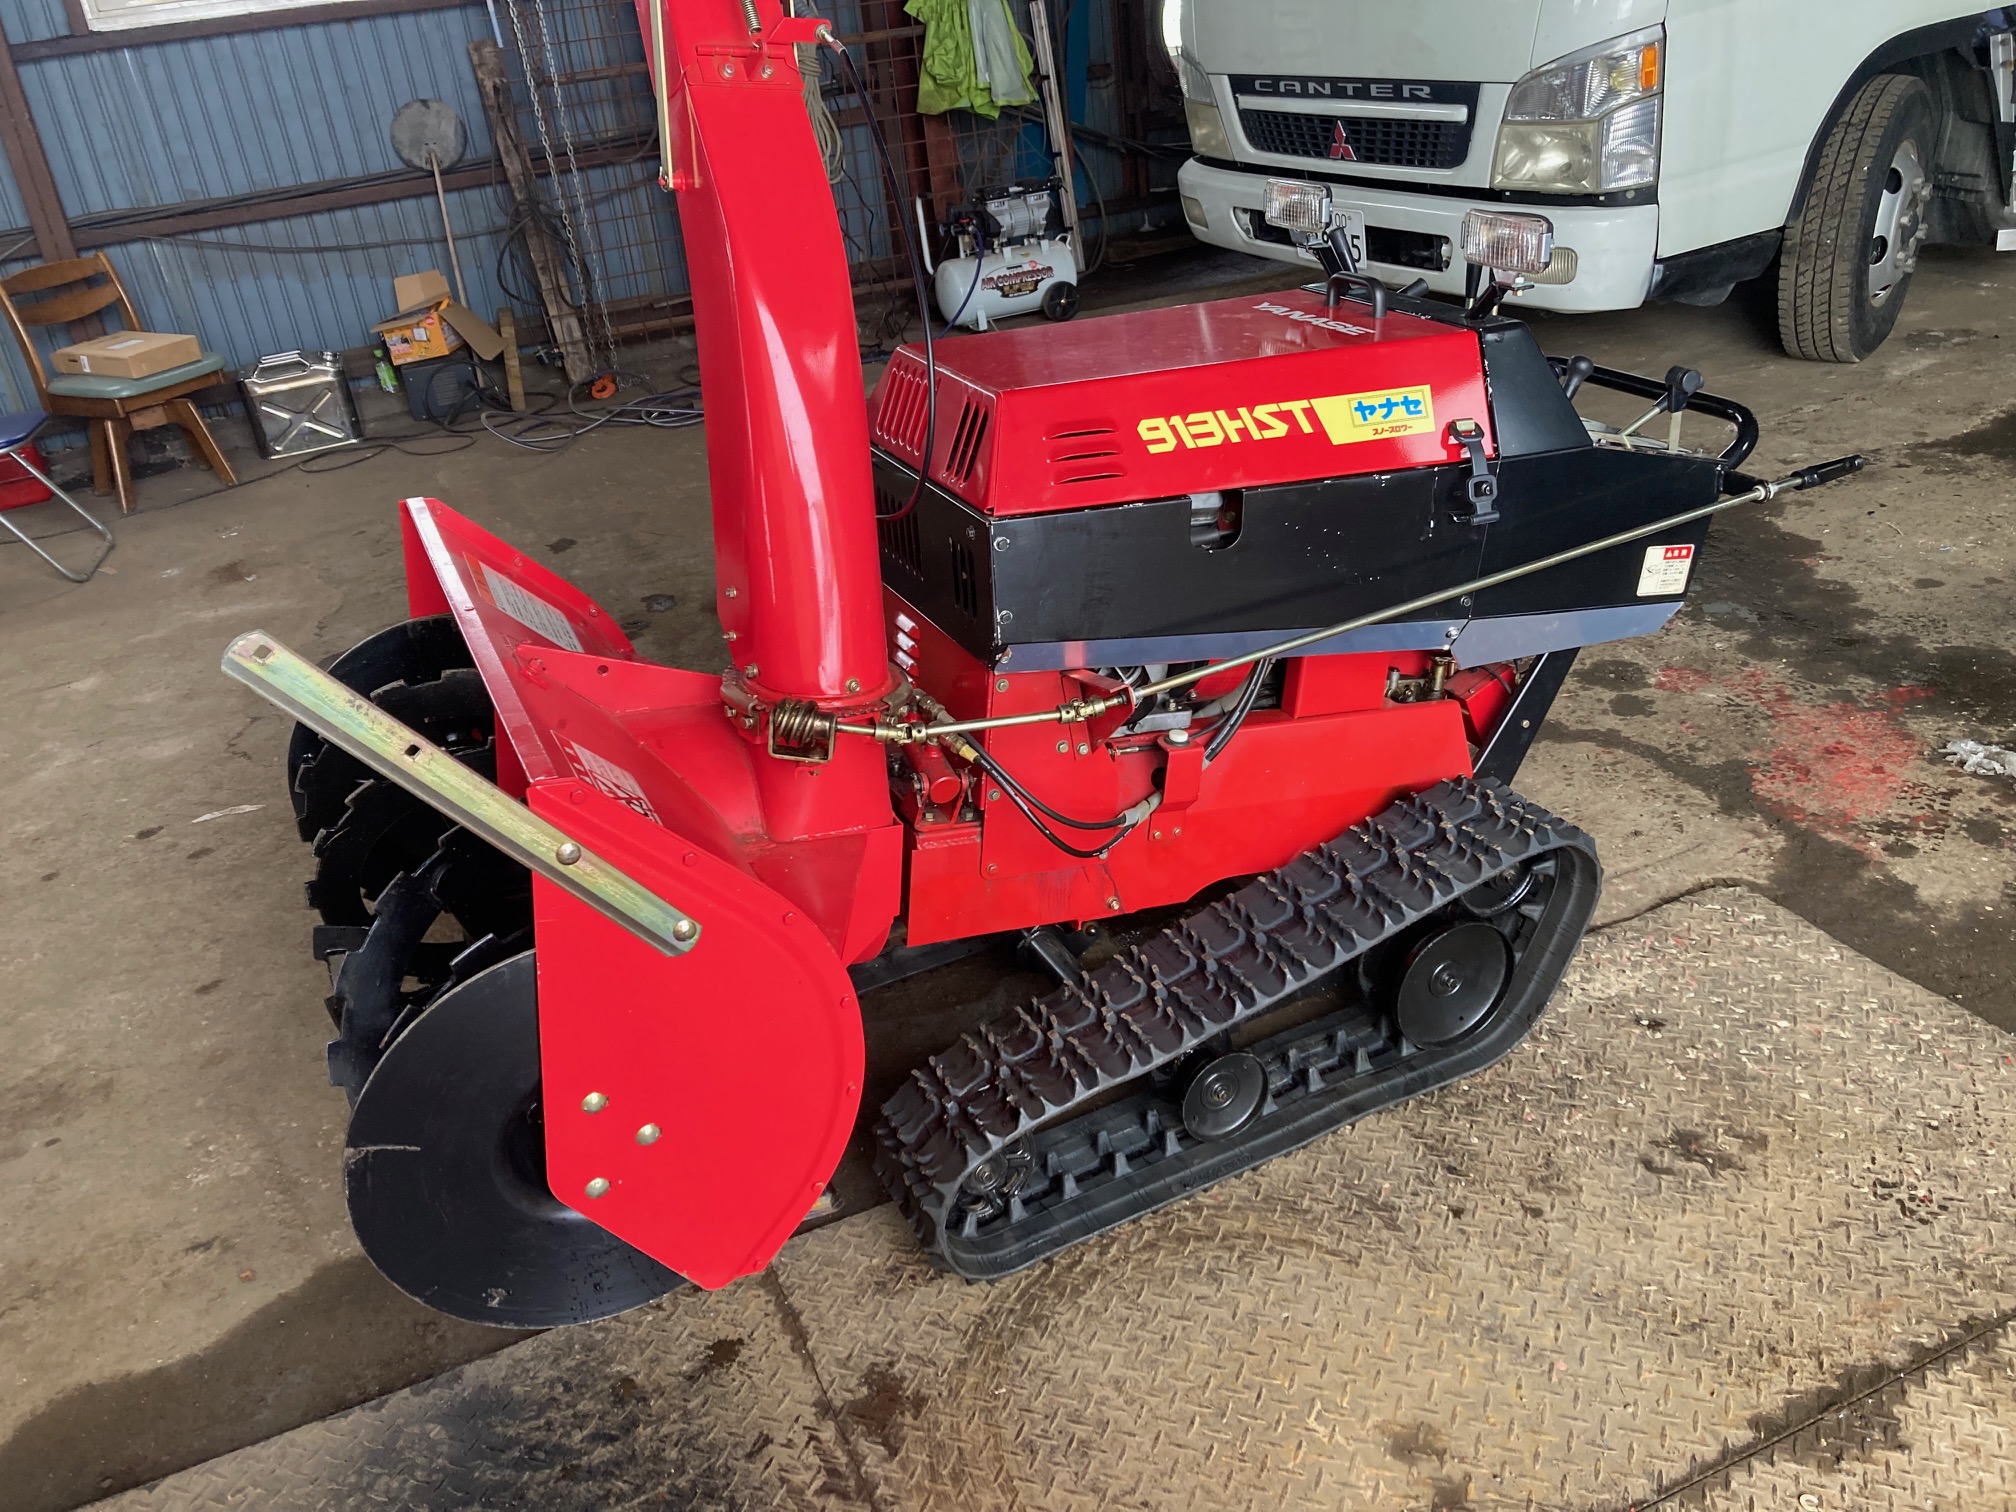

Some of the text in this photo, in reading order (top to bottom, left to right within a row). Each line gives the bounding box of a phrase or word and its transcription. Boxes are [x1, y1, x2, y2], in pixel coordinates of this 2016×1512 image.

[1254, 79, 1433, 99] CANTER
[981, 277, 996, 290] AIR
[997, 266, 1054, 286] COMPRESSOR
[1252, 301, 1377, 336] YANASE
[1353, 395, 1423, 422] ヤナセ
[1136, 400, 1314, 454] 913HST
[1372, 424, 1413, 436] スノースロワー
